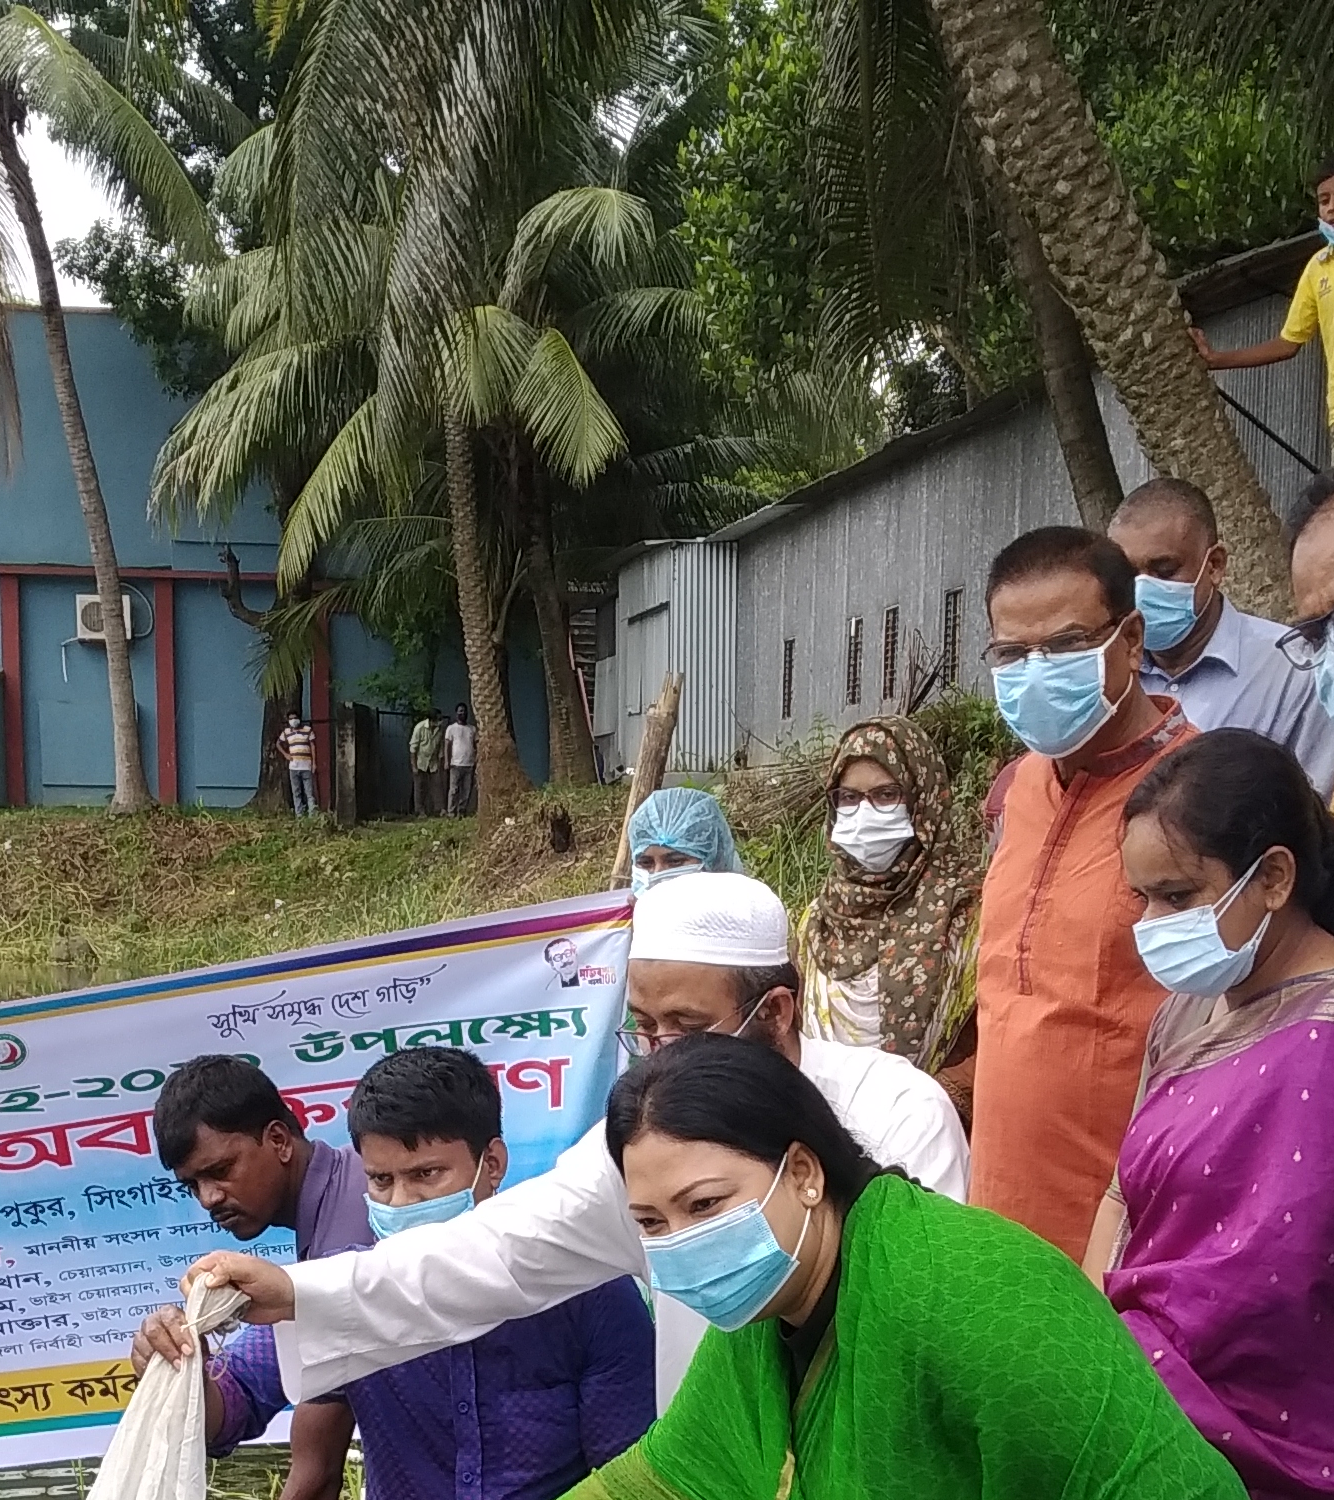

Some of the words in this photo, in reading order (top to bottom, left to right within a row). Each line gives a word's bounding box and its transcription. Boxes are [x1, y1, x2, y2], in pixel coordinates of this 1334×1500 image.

[331, 989, 371, 1018] দেশ
[0, 1197, 76, 1228] পুকুর,
[23, 1234, 98, 1257] মাননীয়
[104, 1228, 162, 1247] সংসদ
[59, 1260, 152, 1282] চেয়ারম্যান,
[28, 1292, 72, 1309] ভাইস
[78, 1282, 160, 1302] চেয়ারম্যান,
[81, 1305, 122, 1322] ভাইস
[30, 1333, 83, 1352] নির্বাহী
